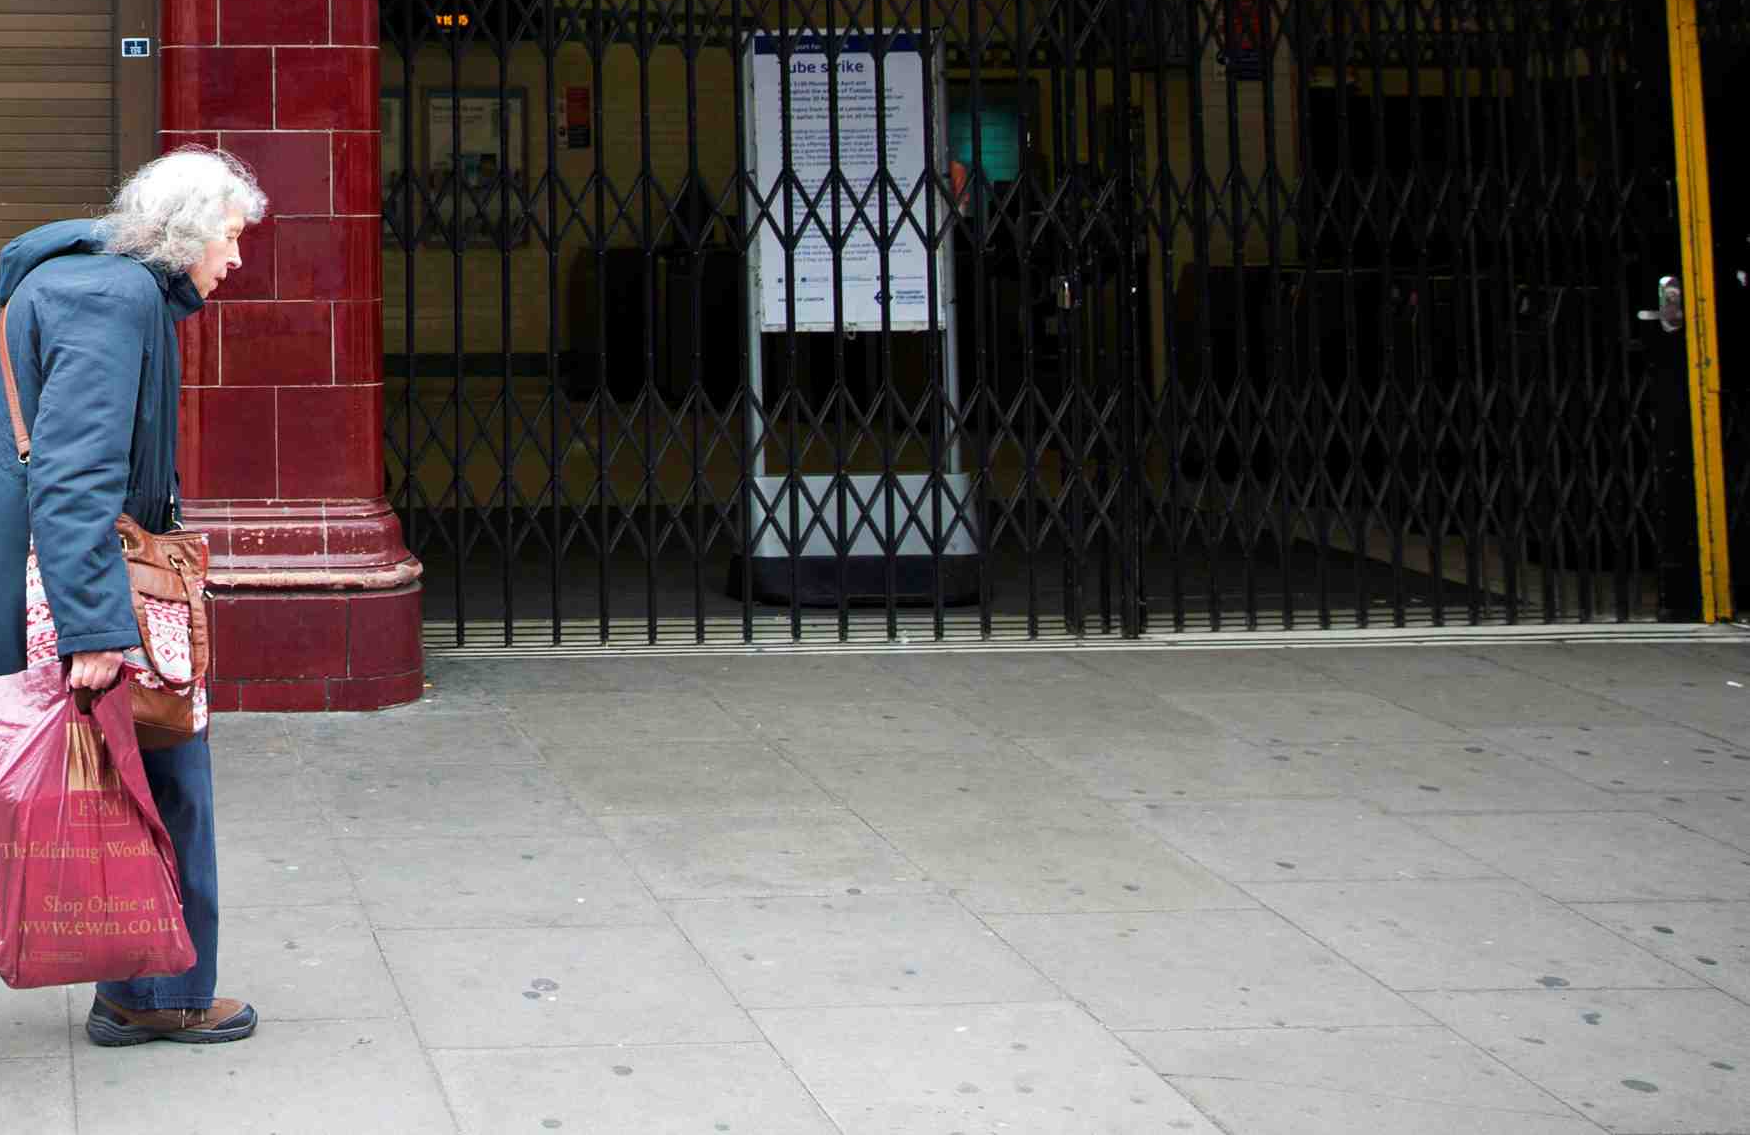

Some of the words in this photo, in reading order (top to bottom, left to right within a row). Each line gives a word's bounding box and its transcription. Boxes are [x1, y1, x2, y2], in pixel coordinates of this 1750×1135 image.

[778, 59, 817, 73] ube
[820, 59, 865, 73] srike
[28, 839, 104, 865] Edinburg
